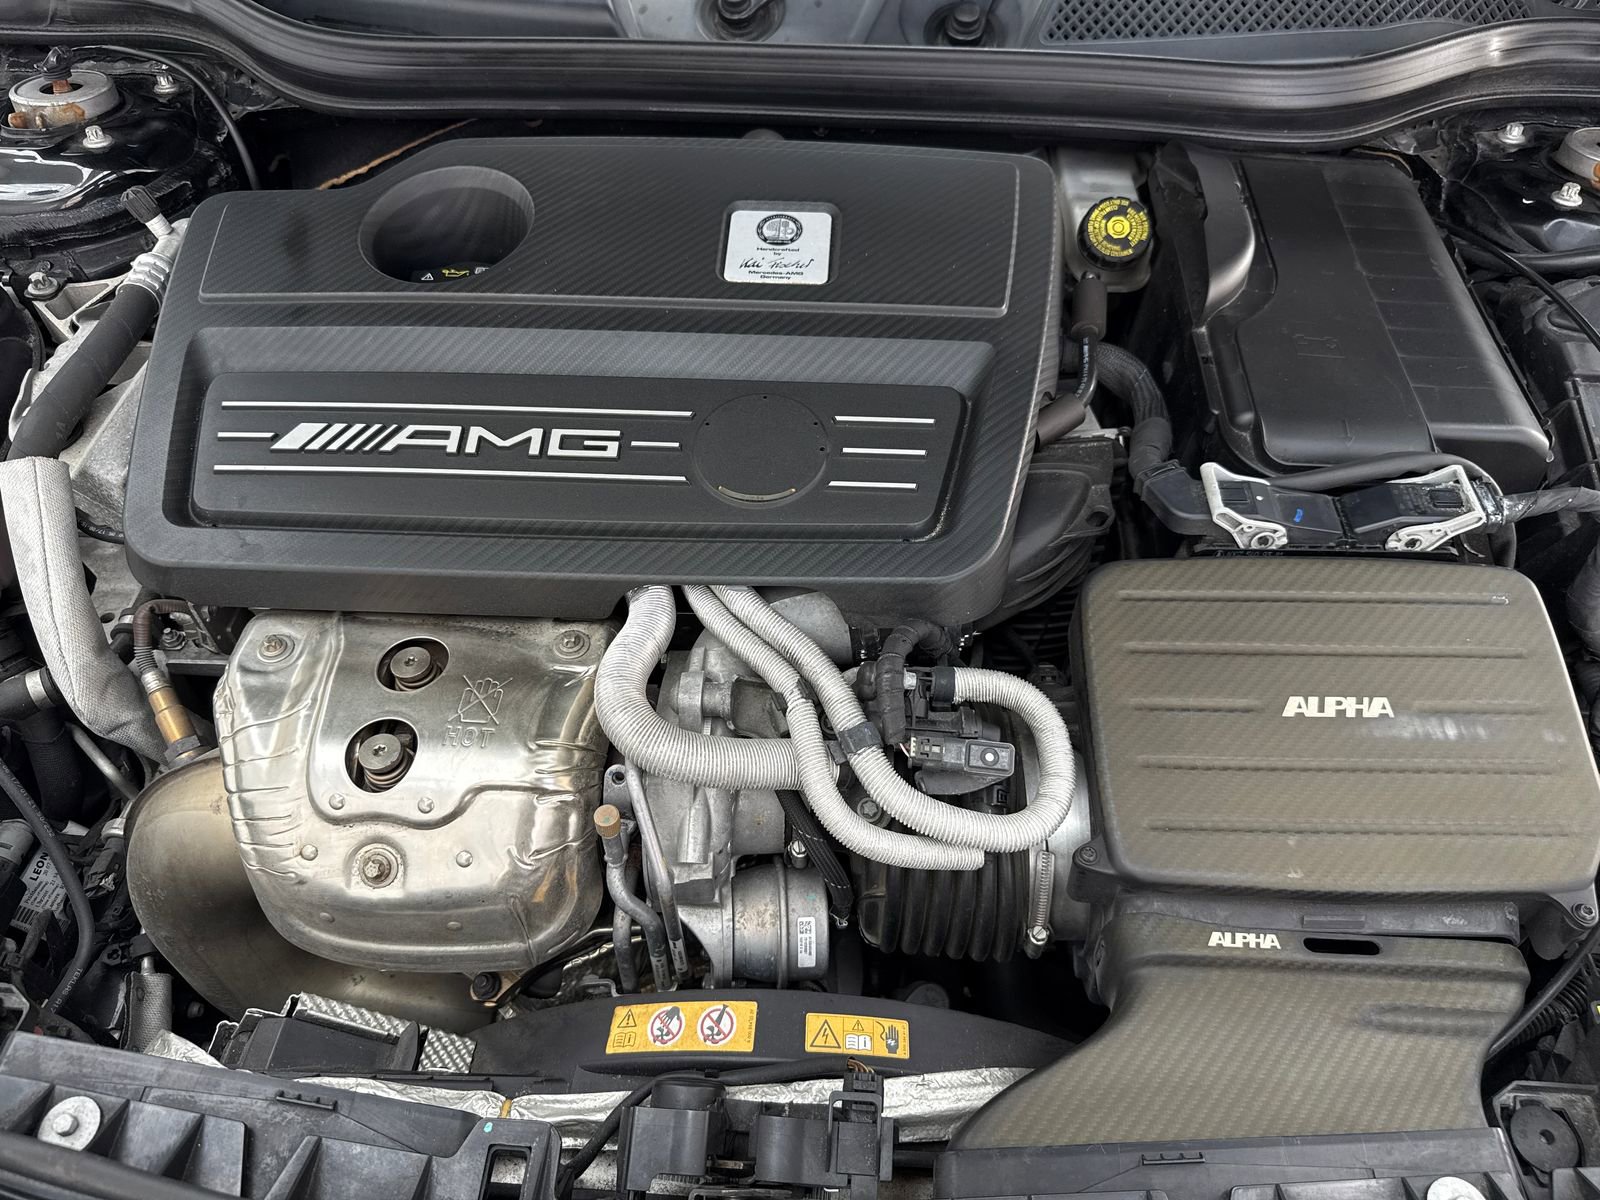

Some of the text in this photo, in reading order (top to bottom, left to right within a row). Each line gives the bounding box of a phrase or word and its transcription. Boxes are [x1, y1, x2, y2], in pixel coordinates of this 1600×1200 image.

[379, 424, 621, 457] AMG
[1281, 695, 1395, 718] ALPHA
[442, 725, 496, 748] HOT
[1207, 931, 1282, 950] ALPHA
[62, 967, 84, 996] TEKLAS
